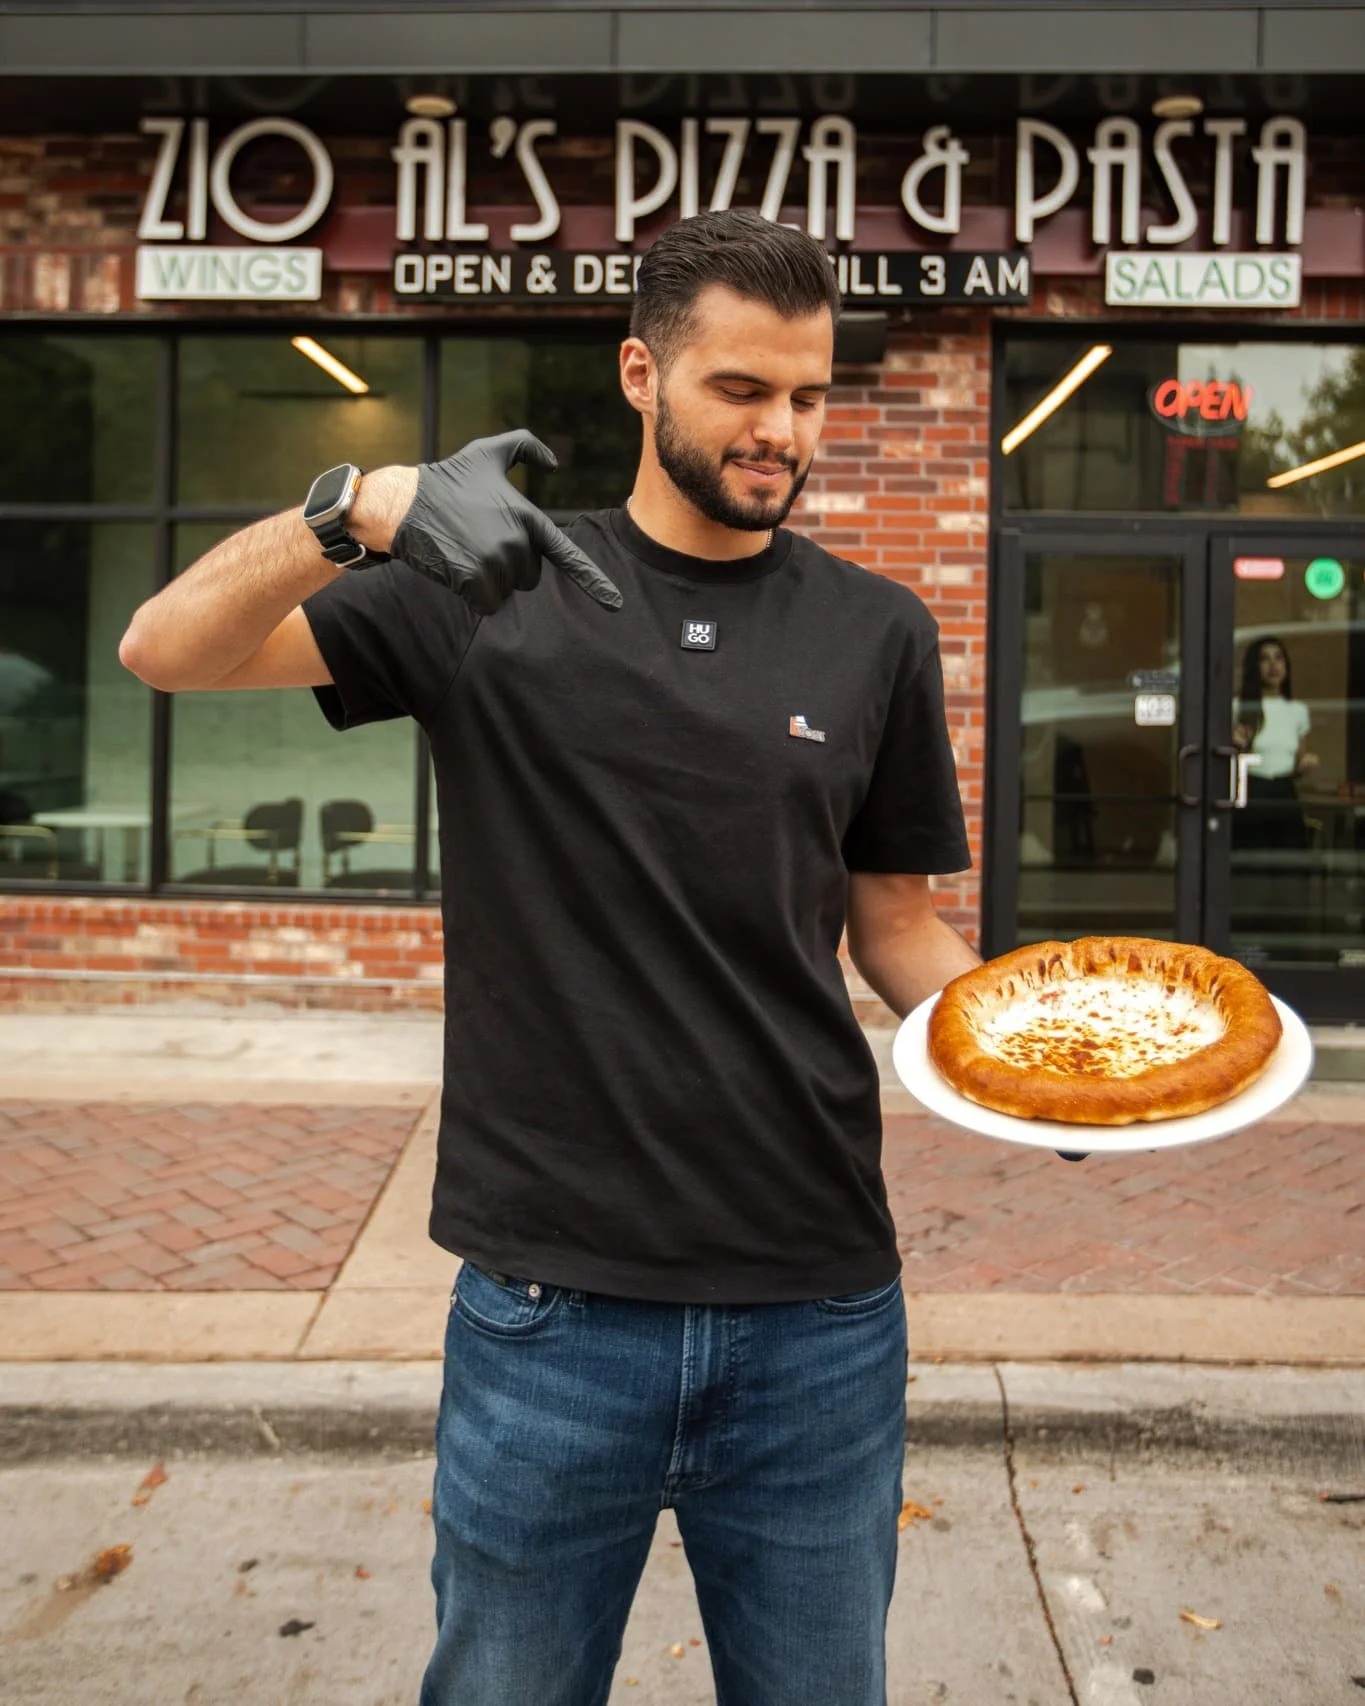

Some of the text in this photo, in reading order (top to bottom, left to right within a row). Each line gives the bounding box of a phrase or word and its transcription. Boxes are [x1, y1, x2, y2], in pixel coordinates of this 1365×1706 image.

[137, 115, 1307, 245] ZIO AL'S PIZZA & PASTA
[152, 252, 308, 294] WINGS
[395, 254, 511, 294] OPEN
[527, 255, 557, 294] &
[827, 255, 903, 296] ILL
[920, 255, 947, 294] 3
[963, 255, 1030, 296] AM
[1113, 259, 1293, 300] SALADS
[1154, 378, 1254, 421] OPEN
